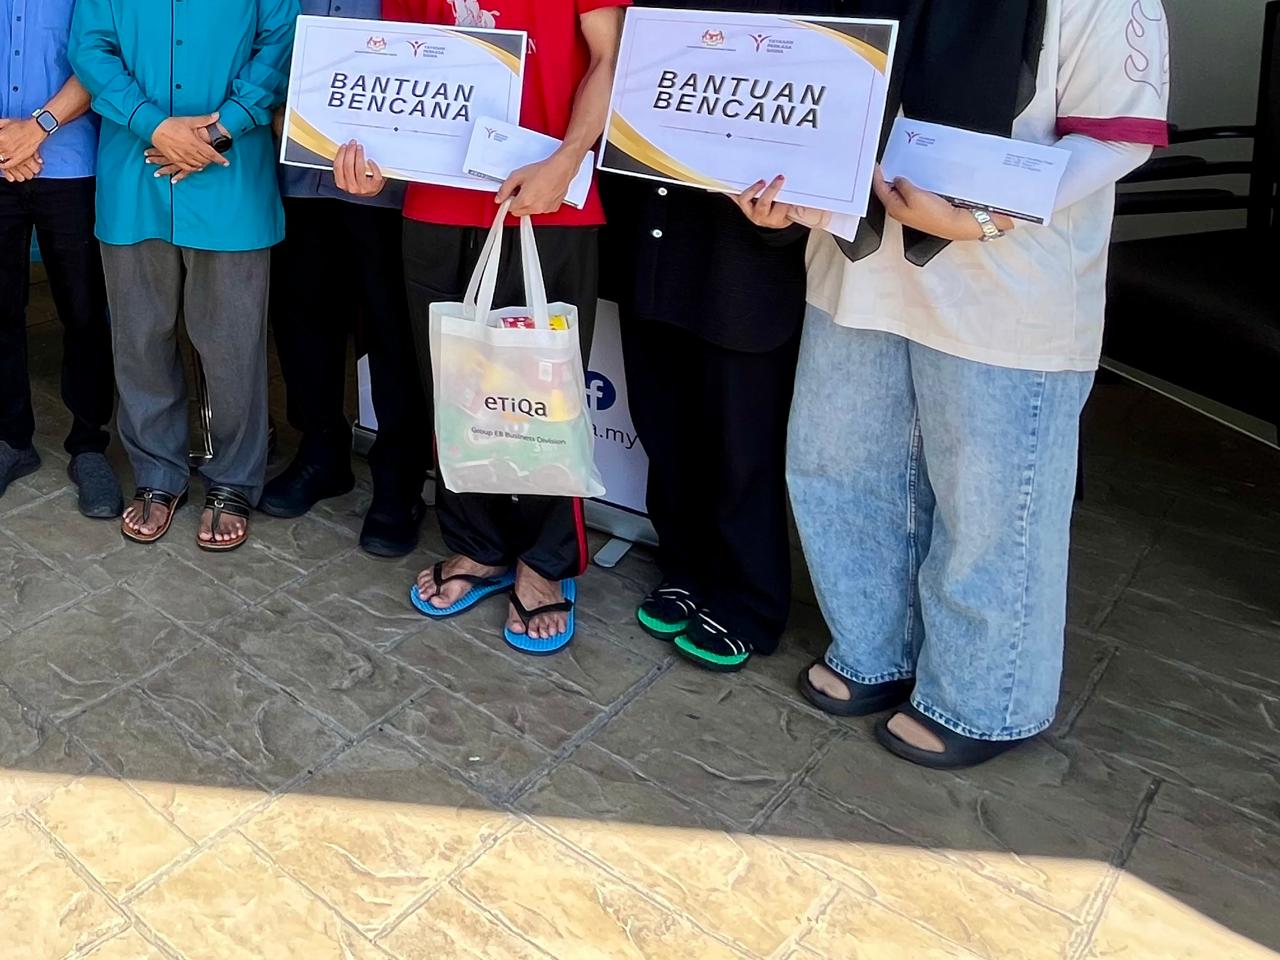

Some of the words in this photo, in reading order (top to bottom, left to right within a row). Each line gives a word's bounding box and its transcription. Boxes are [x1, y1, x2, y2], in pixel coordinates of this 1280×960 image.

[330, 72, 475, 103] BANTUAN
[657, 70, 827, 106] BANTUAN
[327, 91, 471, 122] BENCANA
[653, 91, 821, 129] BENCANA
[471, 426, 494, 437] Group
[505, 431, 535, 442] Business
[537, 436, 567, 445] Division
